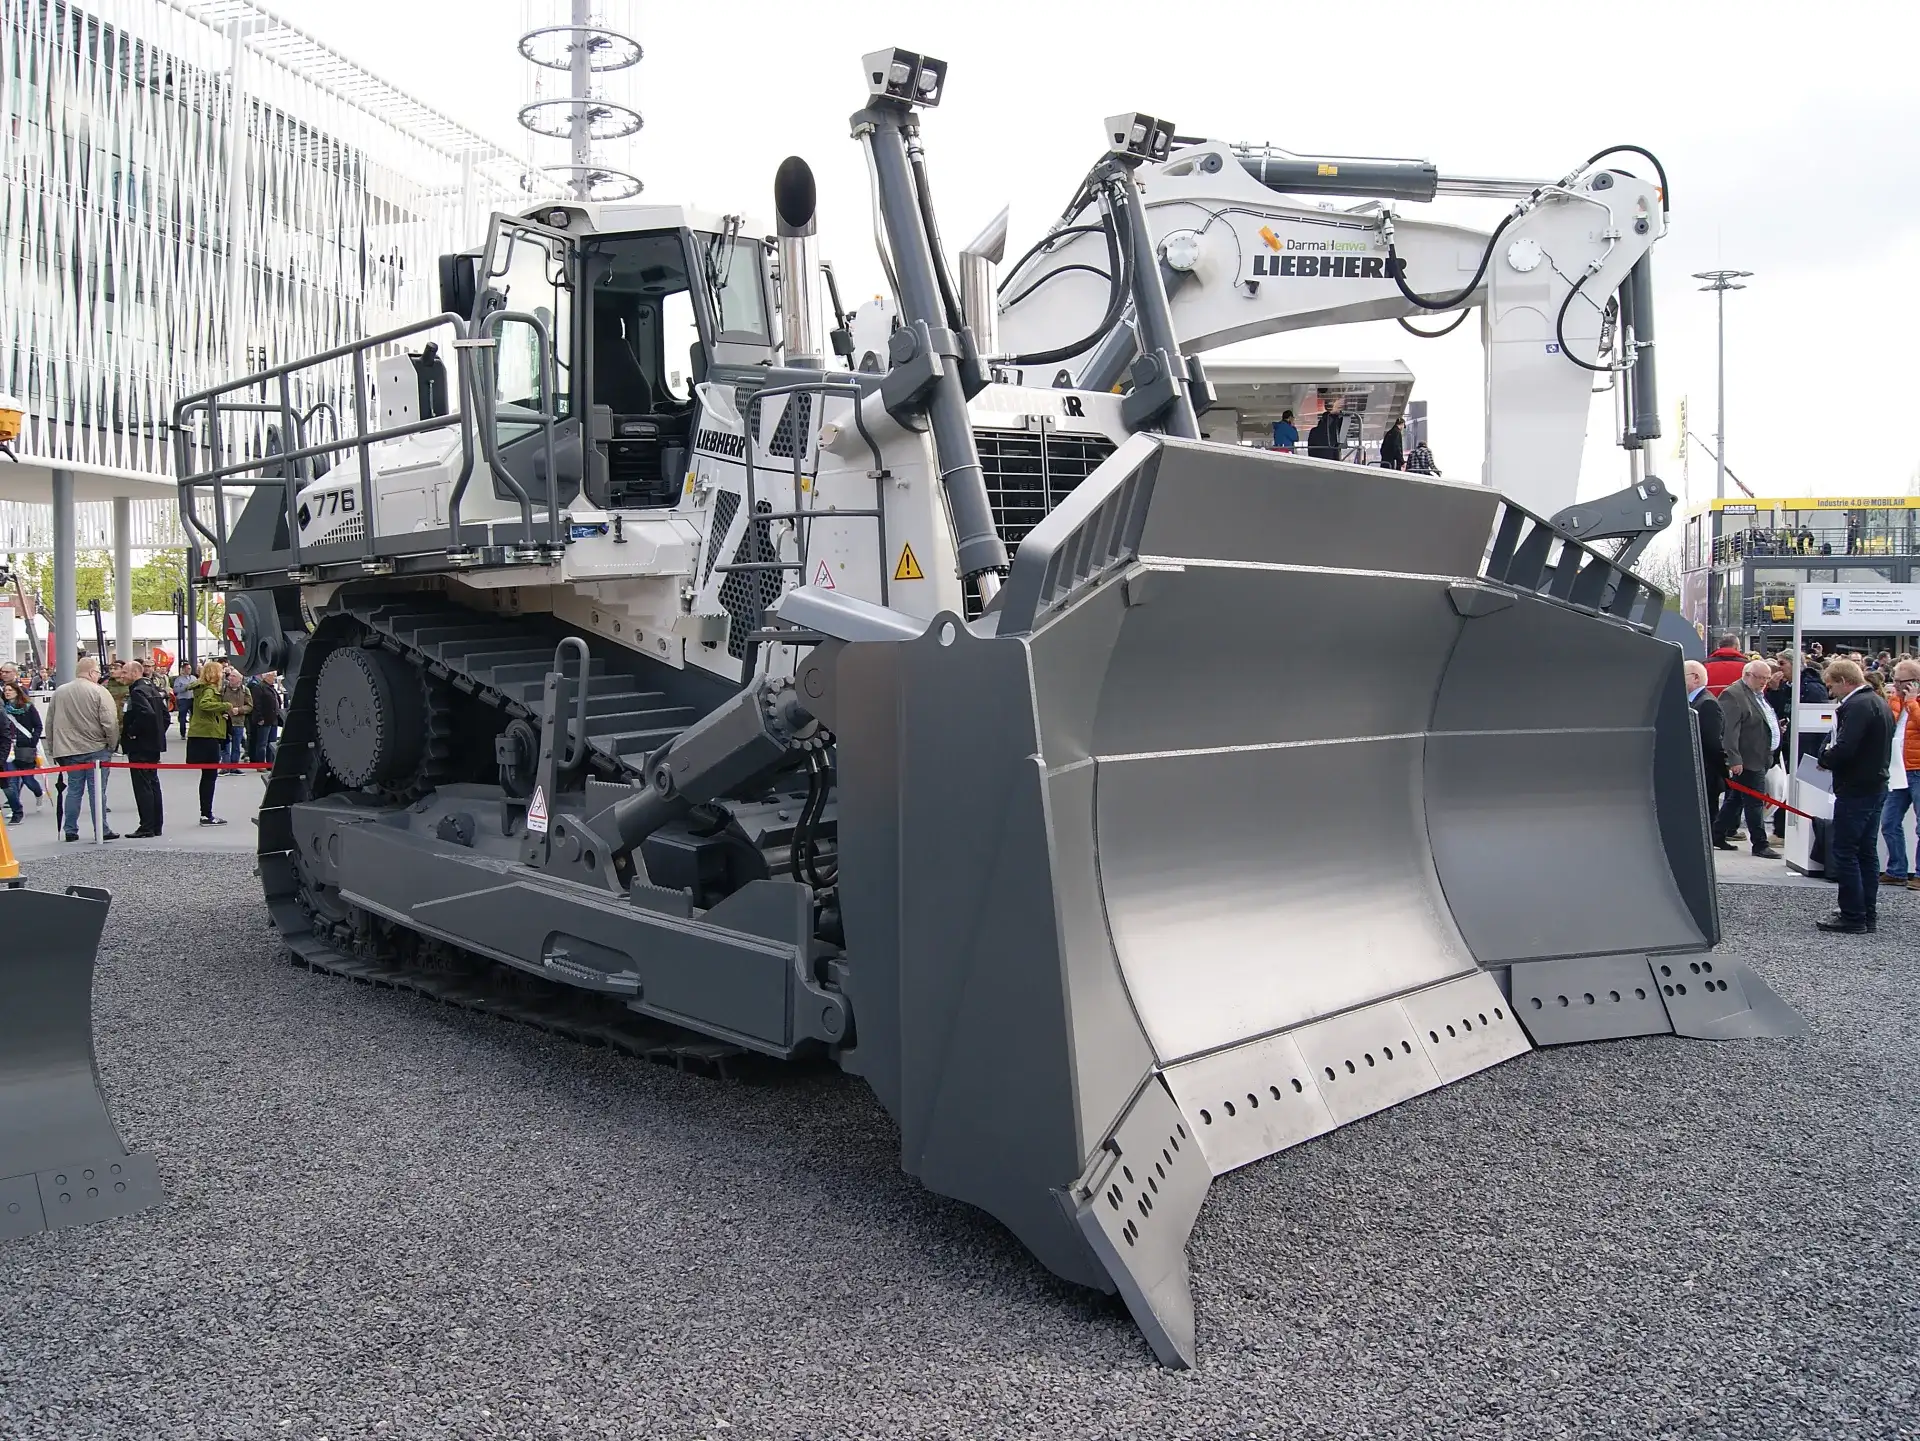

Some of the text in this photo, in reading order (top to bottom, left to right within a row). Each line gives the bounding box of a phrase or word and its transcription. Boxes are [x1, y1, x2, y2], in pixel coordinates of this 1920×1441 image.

[1286, 239, 1366, 251] DarmaHenwa
[1253, 255, 1407, 279] LIEBHERR
[696, 429, 746, 458] LIEBHERR
[313, 488, 355, 518] 776
[1817, 499, 1849, 507] Industrie
[1850, 499, 1862, 507] 4.0
